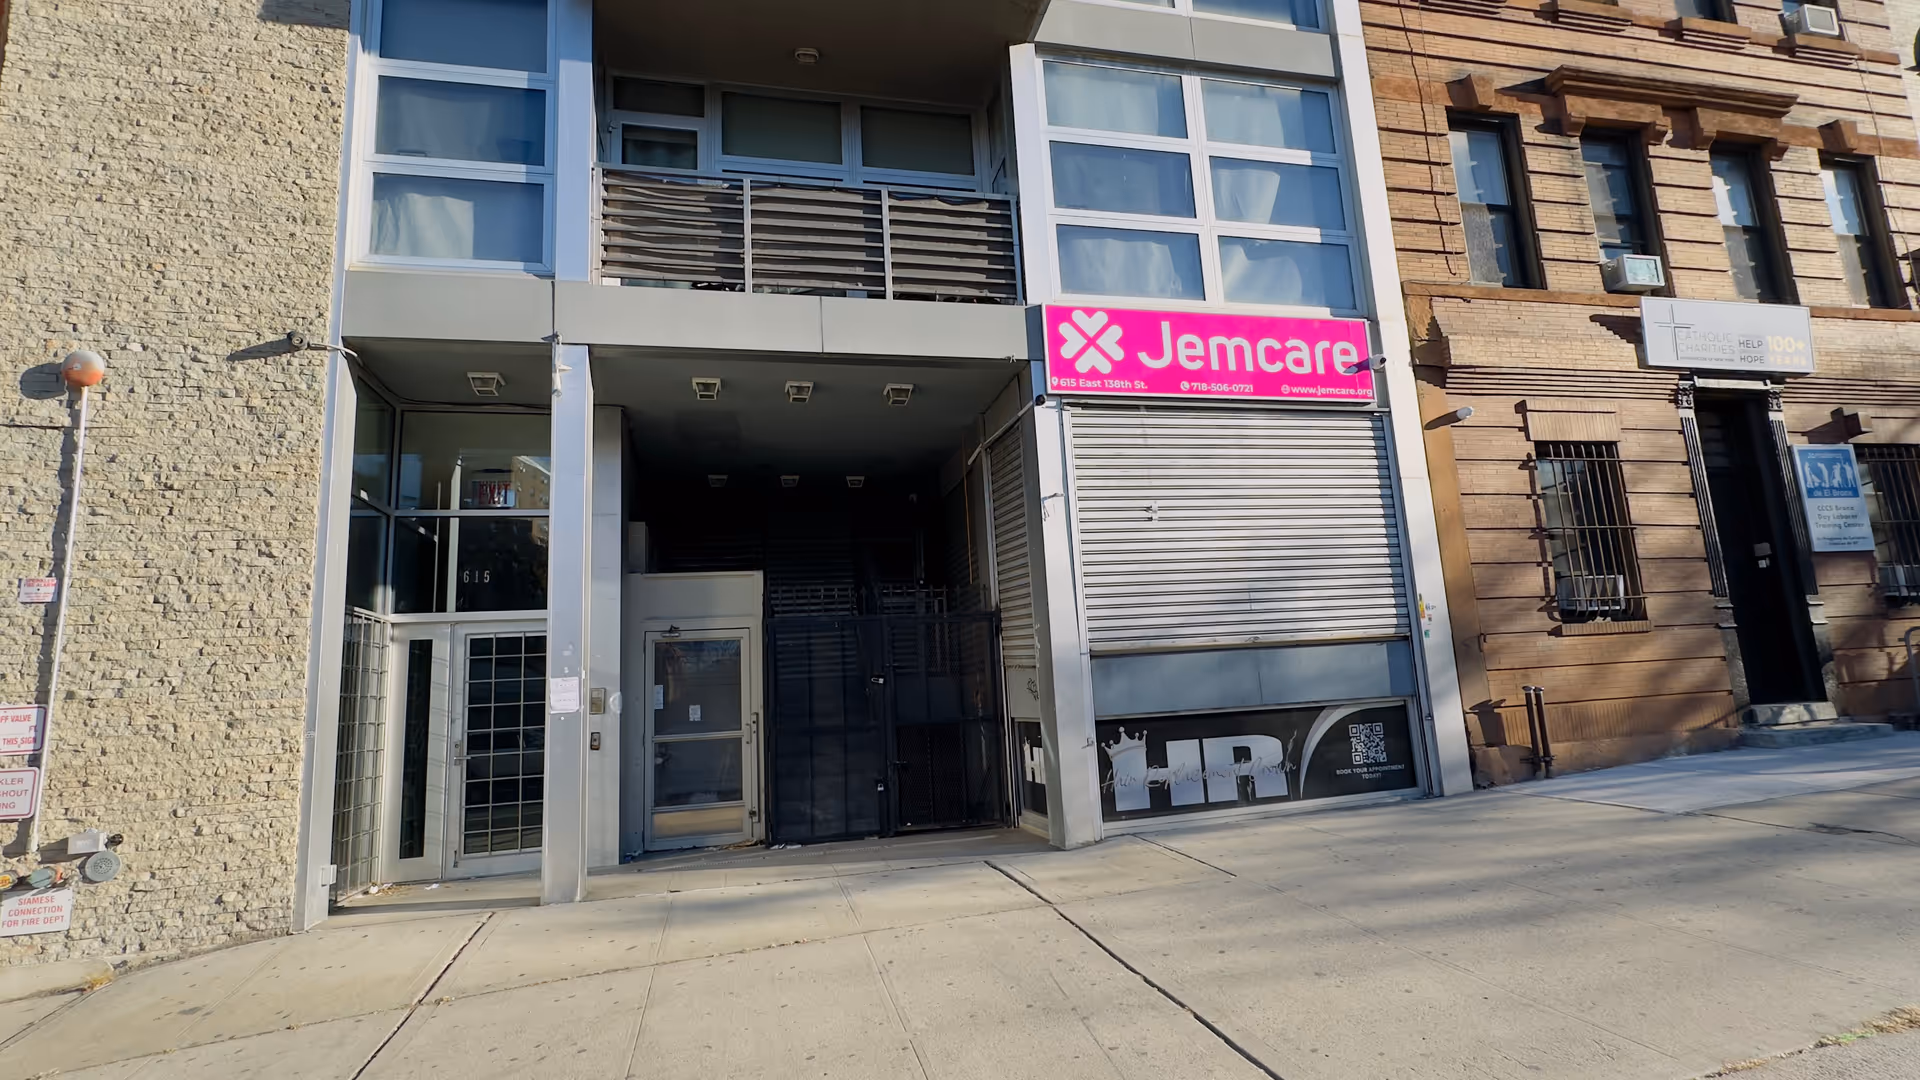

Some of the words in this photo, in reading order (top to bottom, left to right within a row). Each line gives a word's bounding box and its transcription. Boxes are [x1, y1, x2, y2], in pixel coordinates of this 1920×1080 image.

[1677, 329, 1733, 343] CATHOLIC
[1137, 320, 1359, 376] Jemcare
[1678, 342, 1736, 355] CHARITIES
[1739, 339, 1763, 349] HELP
[1767, 335, 1806, 353] 100+
[1740, 355, 1765, 364] HOPE
[1060, 378, 1077, 387] 615
[1079, 378, 1102, 388] East
[1104, 379, 1132, 389] 138th
[1134, 380, 1148, 389] St.
[1191, 382, 1254, 393] 718-506-0721
[1291, 385, 1373, 397] www.jemcare.org
[479, 480, 511, 505] EXIT
[463, 570, 490, 583] 615
[10, 714, 32, 722] VALVE
[3, 737, 19, 746] THIS
[20, 737, 37, 745] SIGN
[1369, 764, 1405, 772] APPOINTMENT
[18, 896, 55, 906] SIAMESE
[8, 905, 63, 917] CONNECTION
[2, 919, 19, 928] FOR
[21, 917, 40, 926] FIRE
[43, 915, 65, 925] DEPT
